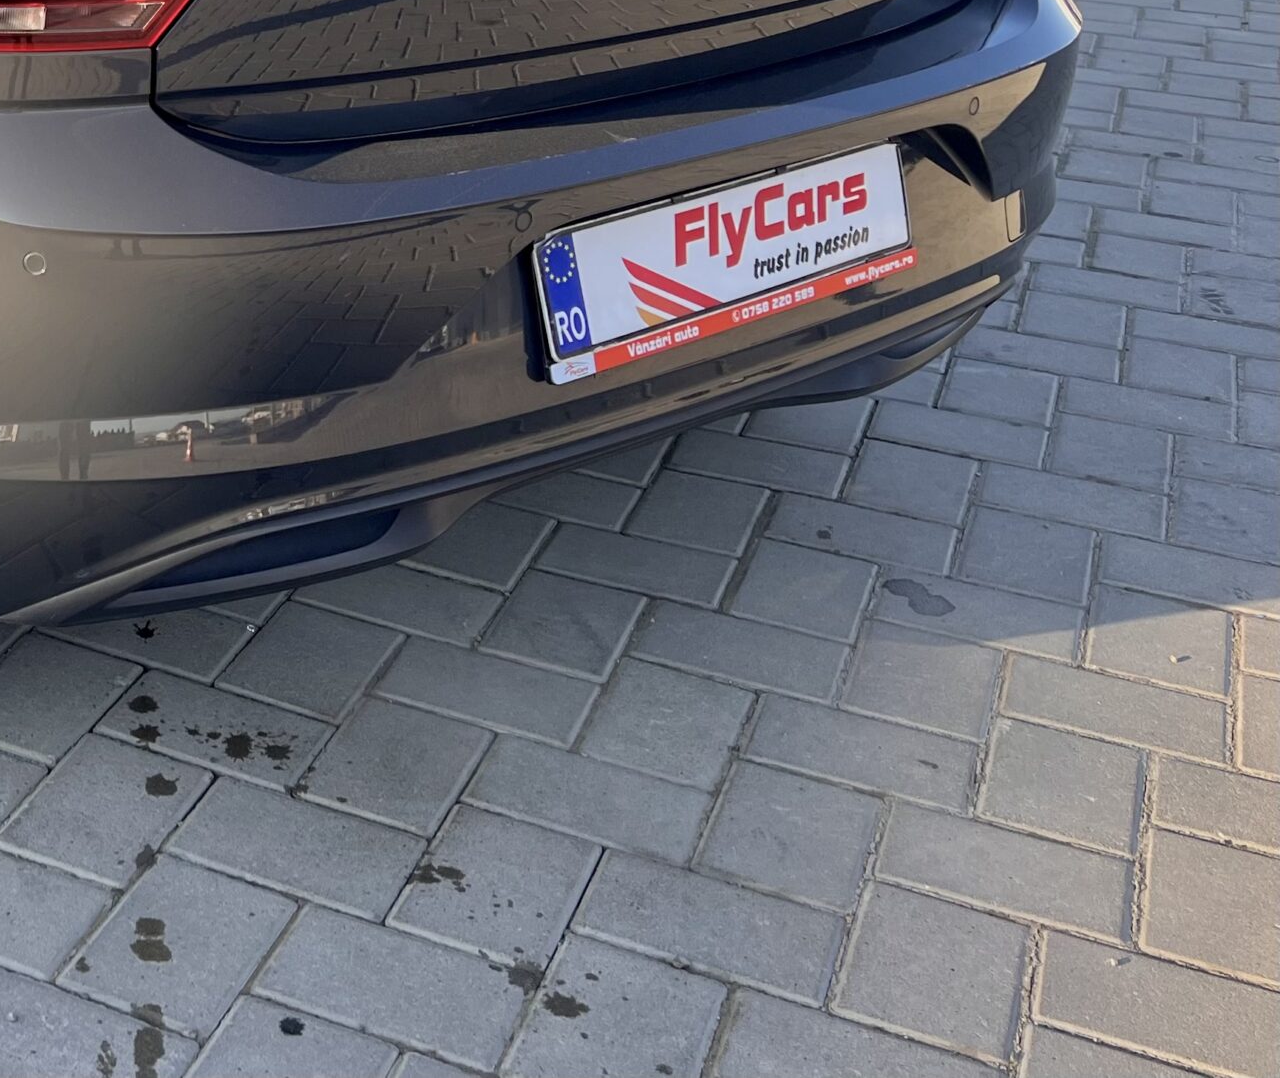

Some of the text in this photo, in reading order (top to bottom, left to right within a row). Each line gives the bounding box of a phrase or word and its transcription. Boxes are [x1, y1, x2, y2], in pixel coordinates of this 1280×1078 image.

[674, 172, 868, 268] FlyCars
[753, 225, 870, 279] trust in passion
[845, 255, 913, 285] www.flycars.ro
[742, 301, 770, 319] 0758
[771, 296, 793, 310] 220
[557, 305, 587, 346] RO
[674, 325, 700, 342] auto
